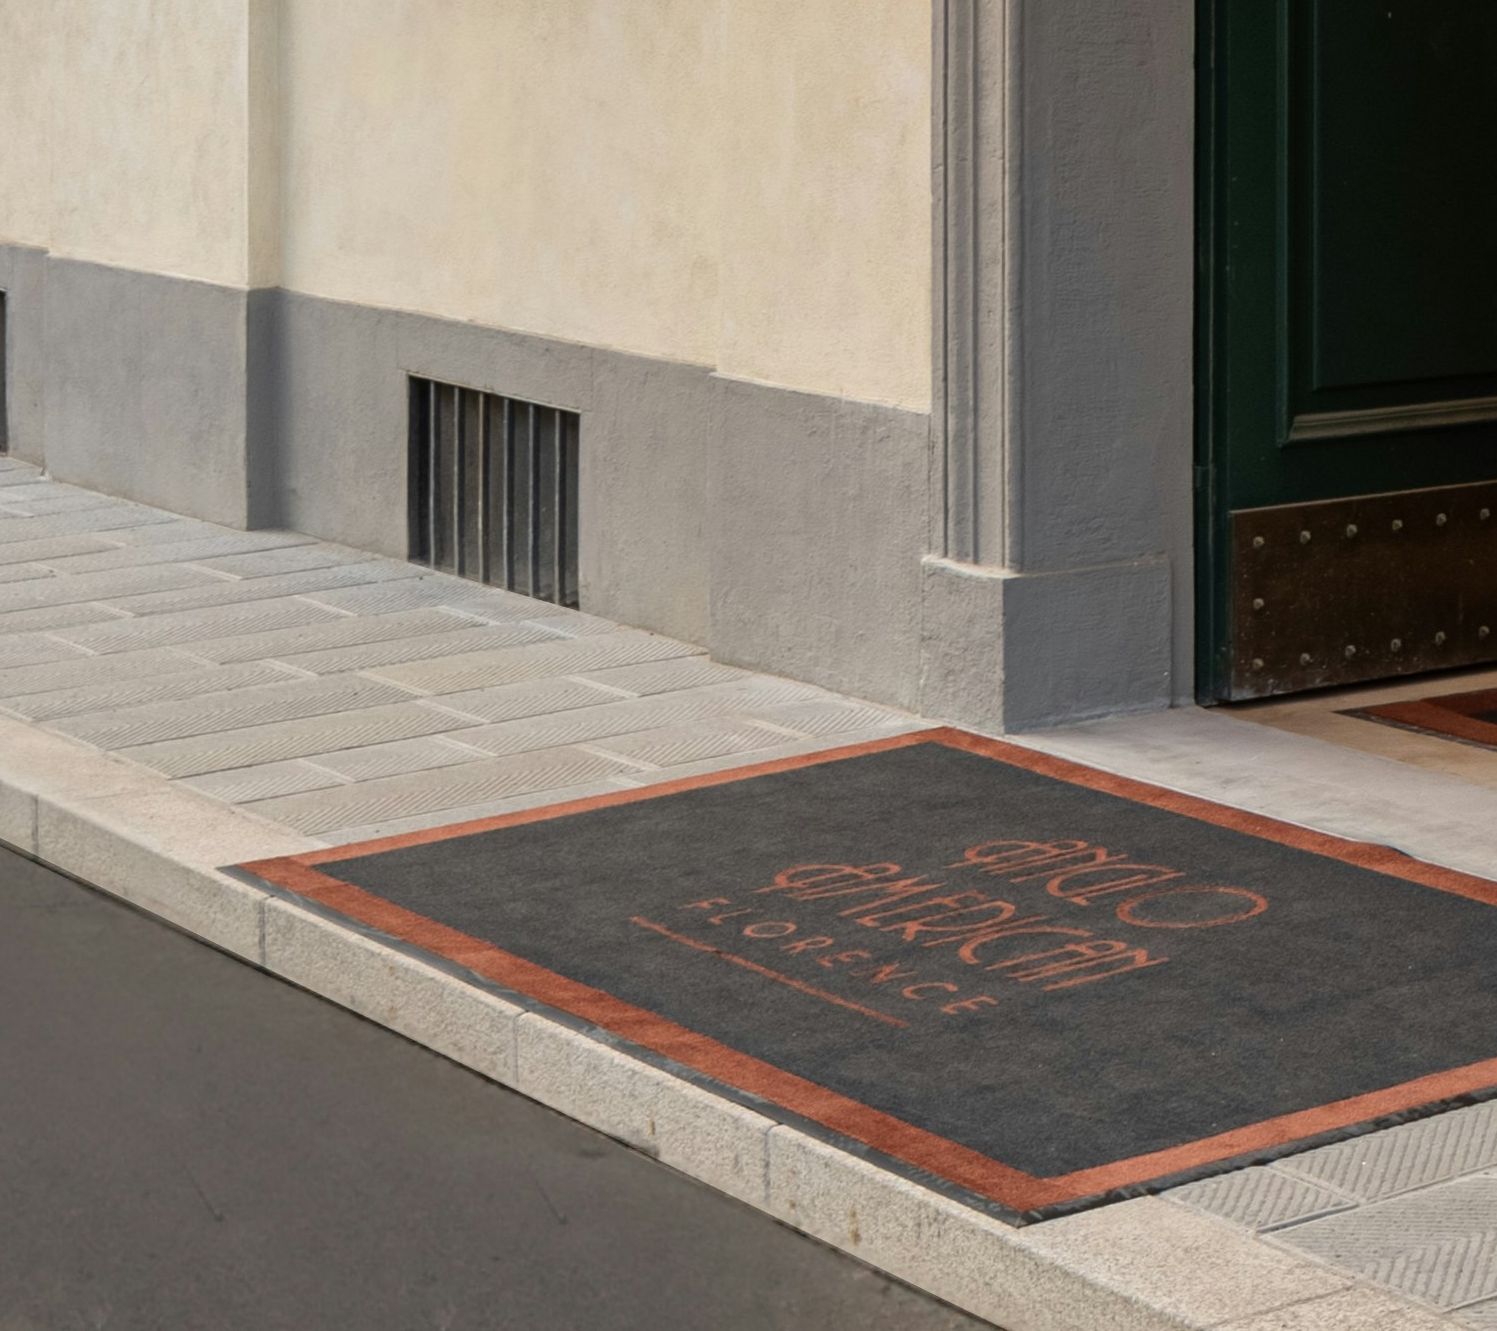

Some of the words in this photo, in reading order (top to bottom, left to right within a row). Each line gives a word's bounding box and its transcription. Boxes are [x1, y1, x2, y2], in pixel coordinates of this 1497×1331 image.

[753, 862, 1170, 991] AMERICAN
[942, 839, 1269, 929] ANGLO
[677, 896, 999, 1015] FLORENCE
